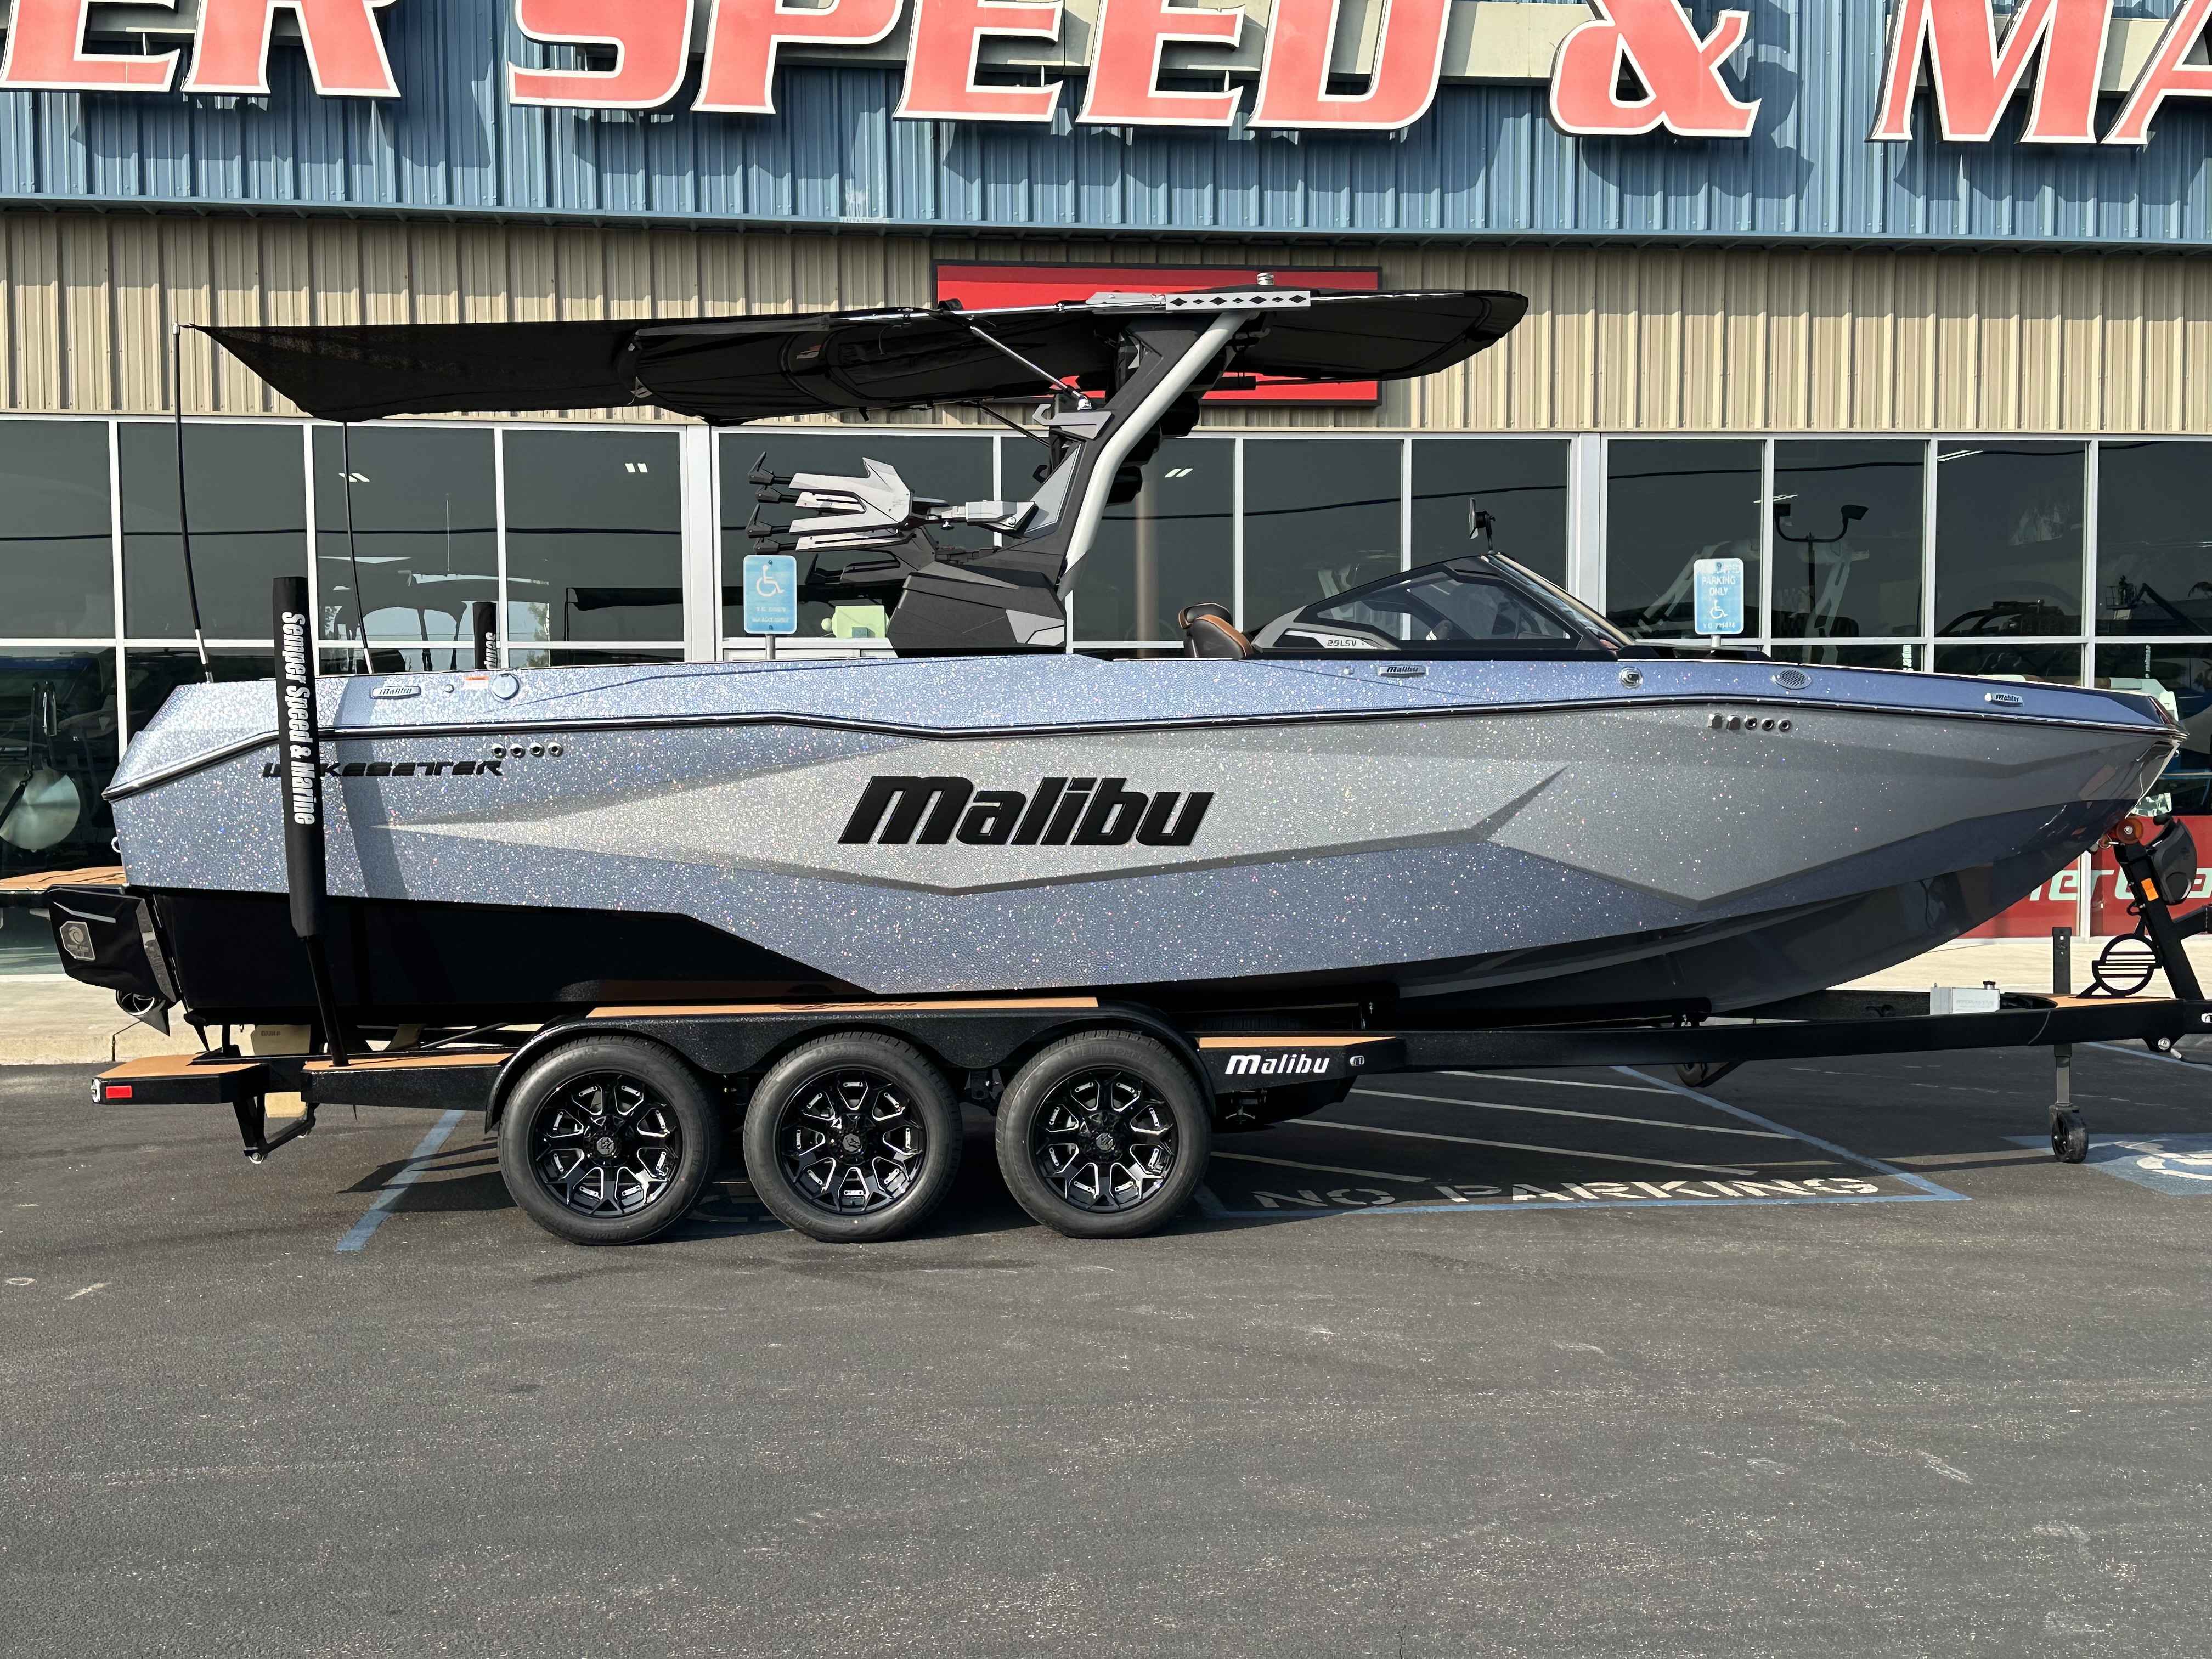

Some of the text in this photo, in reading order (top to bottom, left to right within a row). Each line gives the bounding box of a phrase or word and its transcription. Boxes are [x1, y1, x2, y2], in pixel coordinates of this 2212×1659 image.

[508, 0, 1452, 130] SPEED
[1549, 0, 1761, 137] &
[1702, 575, 1736, 585] PARKING
[1709, 587, 1728, 596] ONLY
[281, 612, 317, 825] Semper Speed & Marine
[837, 776, 1214, 846] Malibu
[1225, 1054, 1330, 1074] Malibu
[1251, 1178, 1880, 1208] NO PARKING
